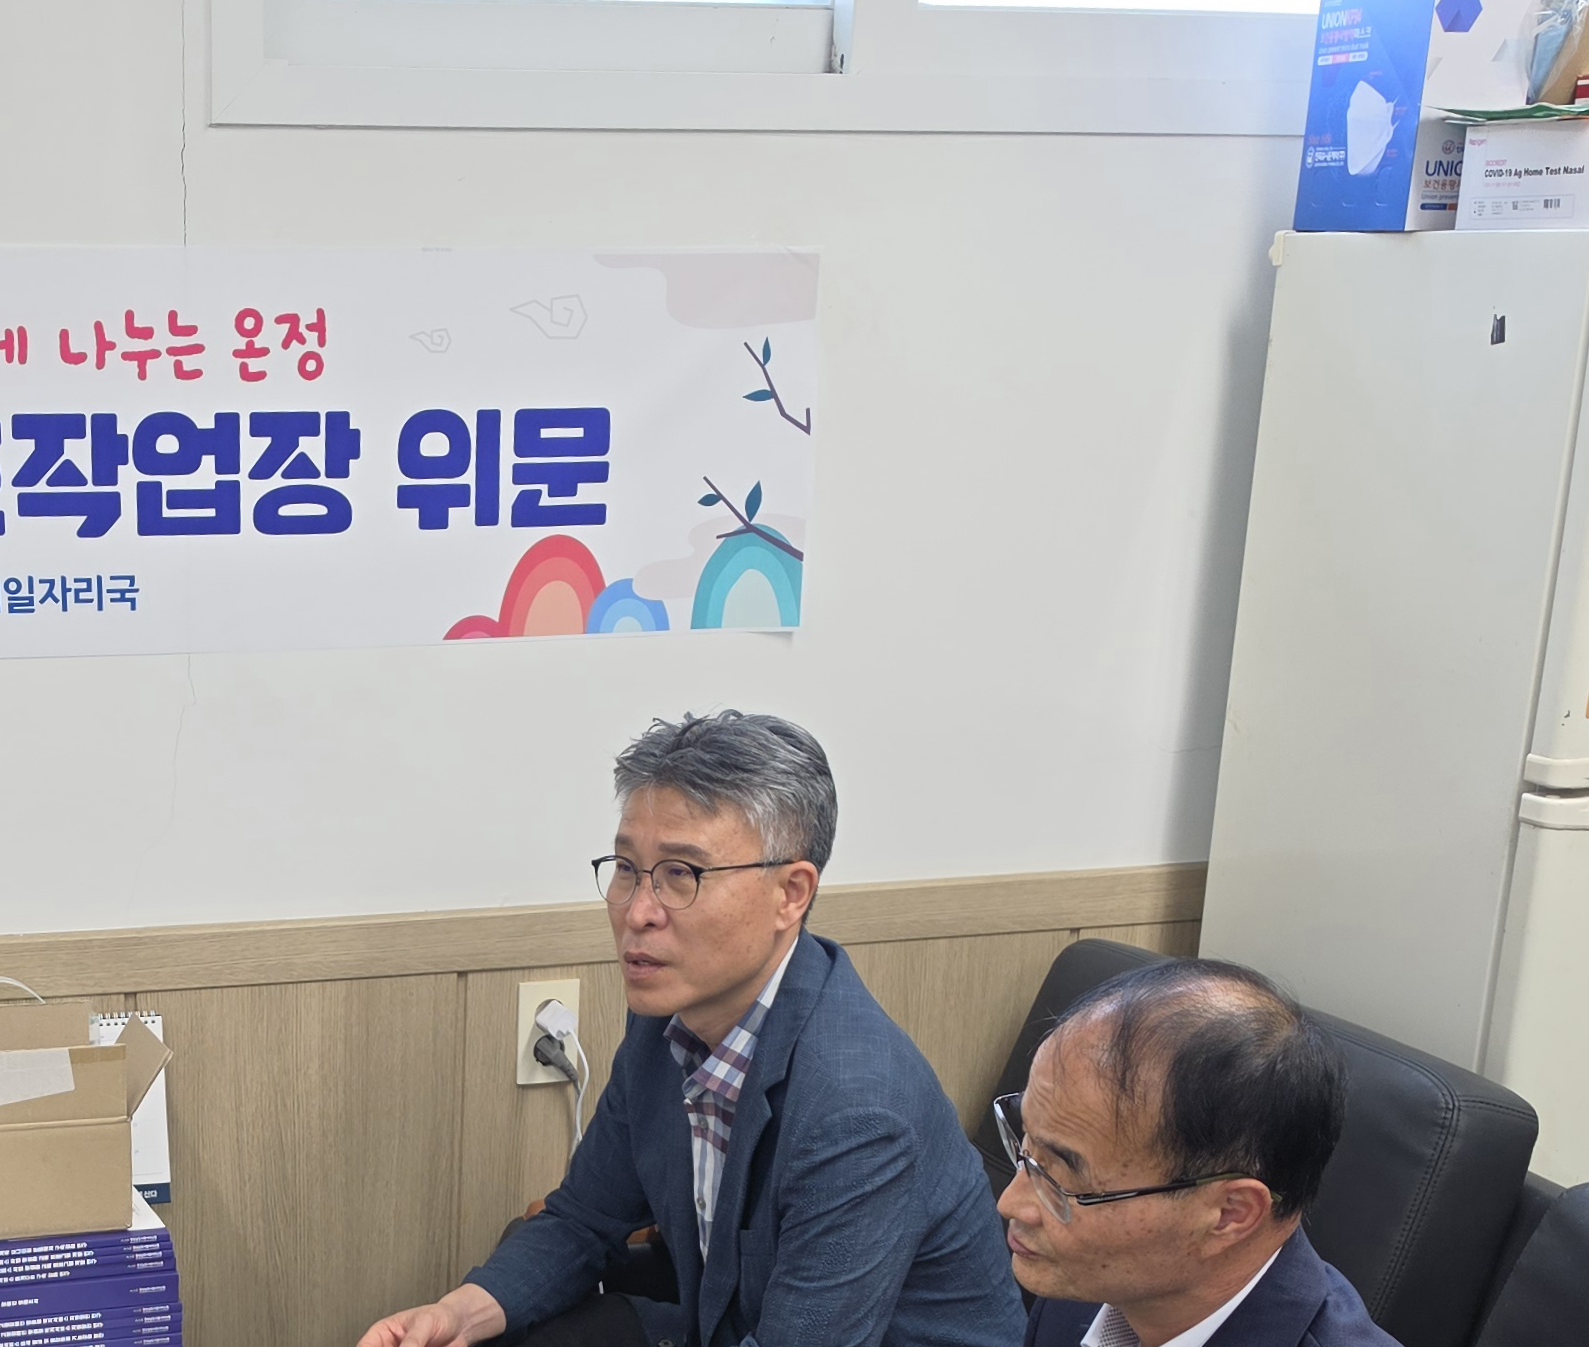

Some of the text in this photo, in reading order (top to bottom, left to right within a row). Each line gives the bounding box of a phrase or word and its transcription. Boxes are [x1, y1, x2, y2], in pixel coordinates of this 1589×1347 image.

[1484, 165, 1585, 179] COVID-19 Ag Home Test Nasal
[59, 309, 205, 382] 나누는
[232, 307, 328, 383] 온정
[396, 406, 611, 531] 위문
